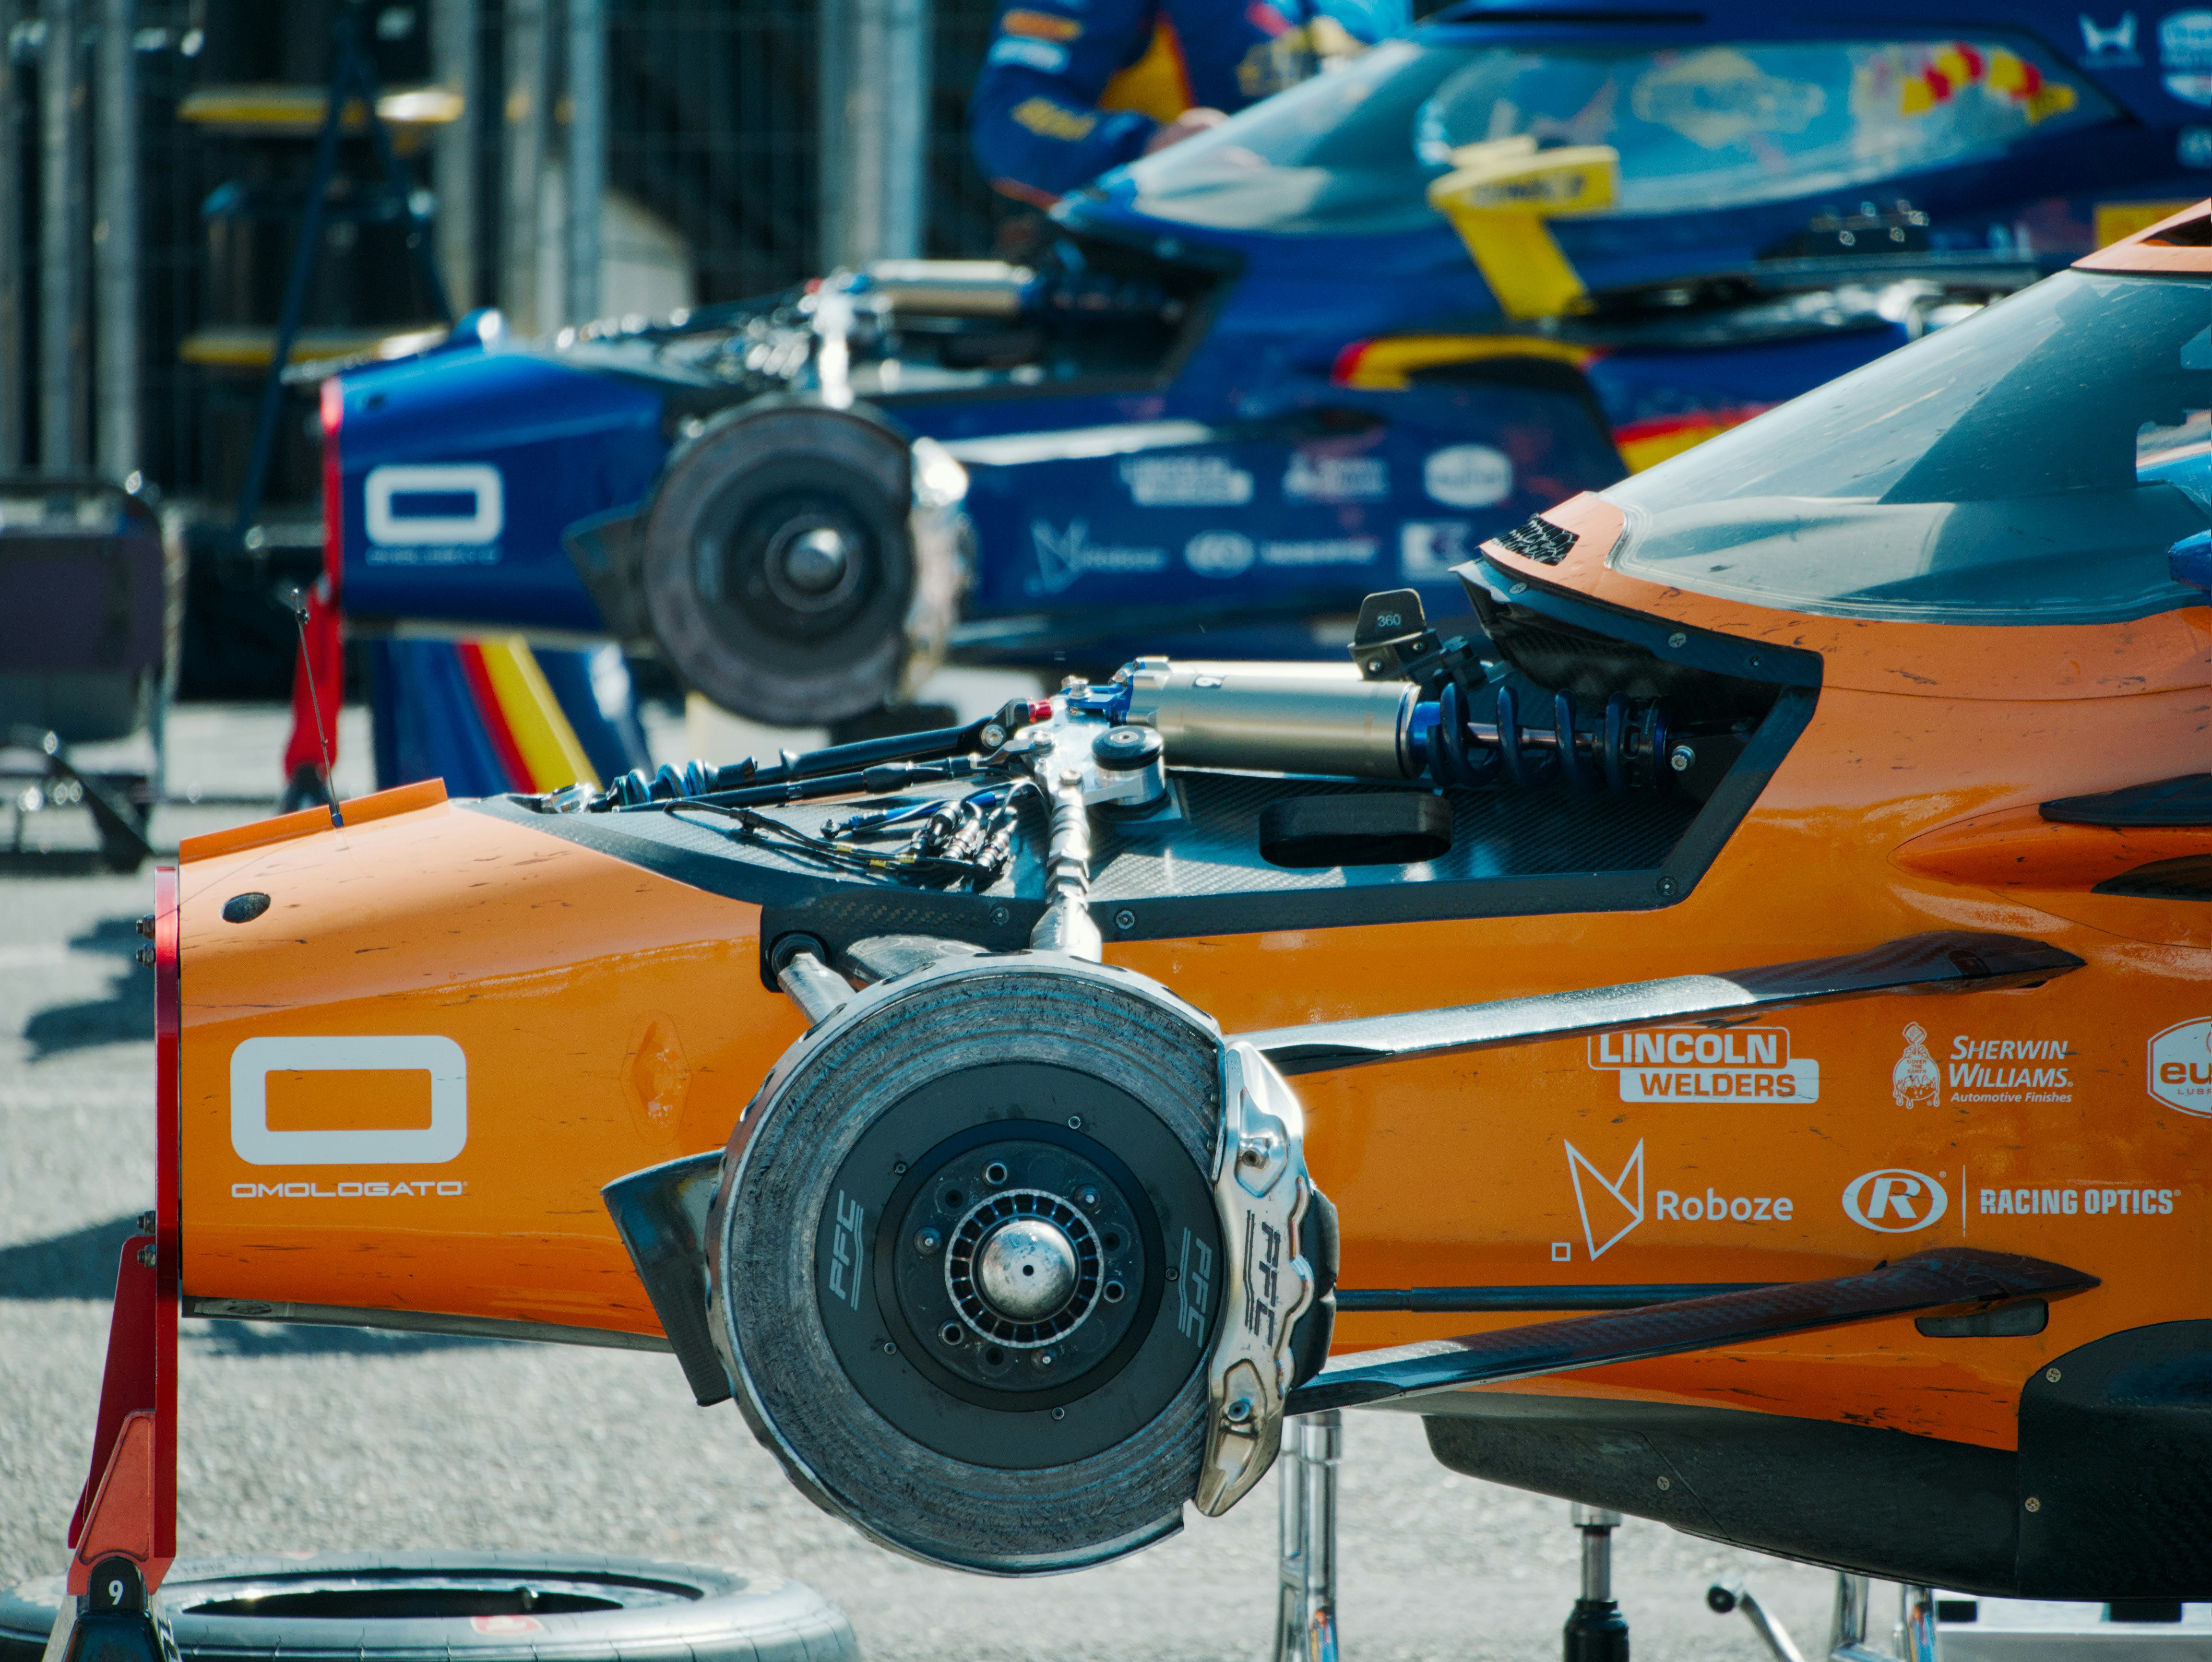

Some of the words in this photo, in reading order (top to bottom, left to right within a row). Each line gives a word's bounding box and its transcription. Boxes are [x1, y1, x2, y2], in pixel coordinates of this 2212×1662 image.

[1377, 614, 1402, 627] 360
[1599, 1033, 1777, 1064] LINCOLN
[1950, 1035, 2068, 1060] SHERWIN
[1640, 1073, 1796, 1097] WELDERS
[1950, 1092, 2022, 1103] Automotive
[2024, 1092, 2072, 1103] Finishes
[231, 1181, 463, 1198] OMOLOGATO
[1980, 1189, 2078, 1215] RACING
[1656, 1187, 1794, 1221] Roboze
[109, 1580, 124, 1605] 9
